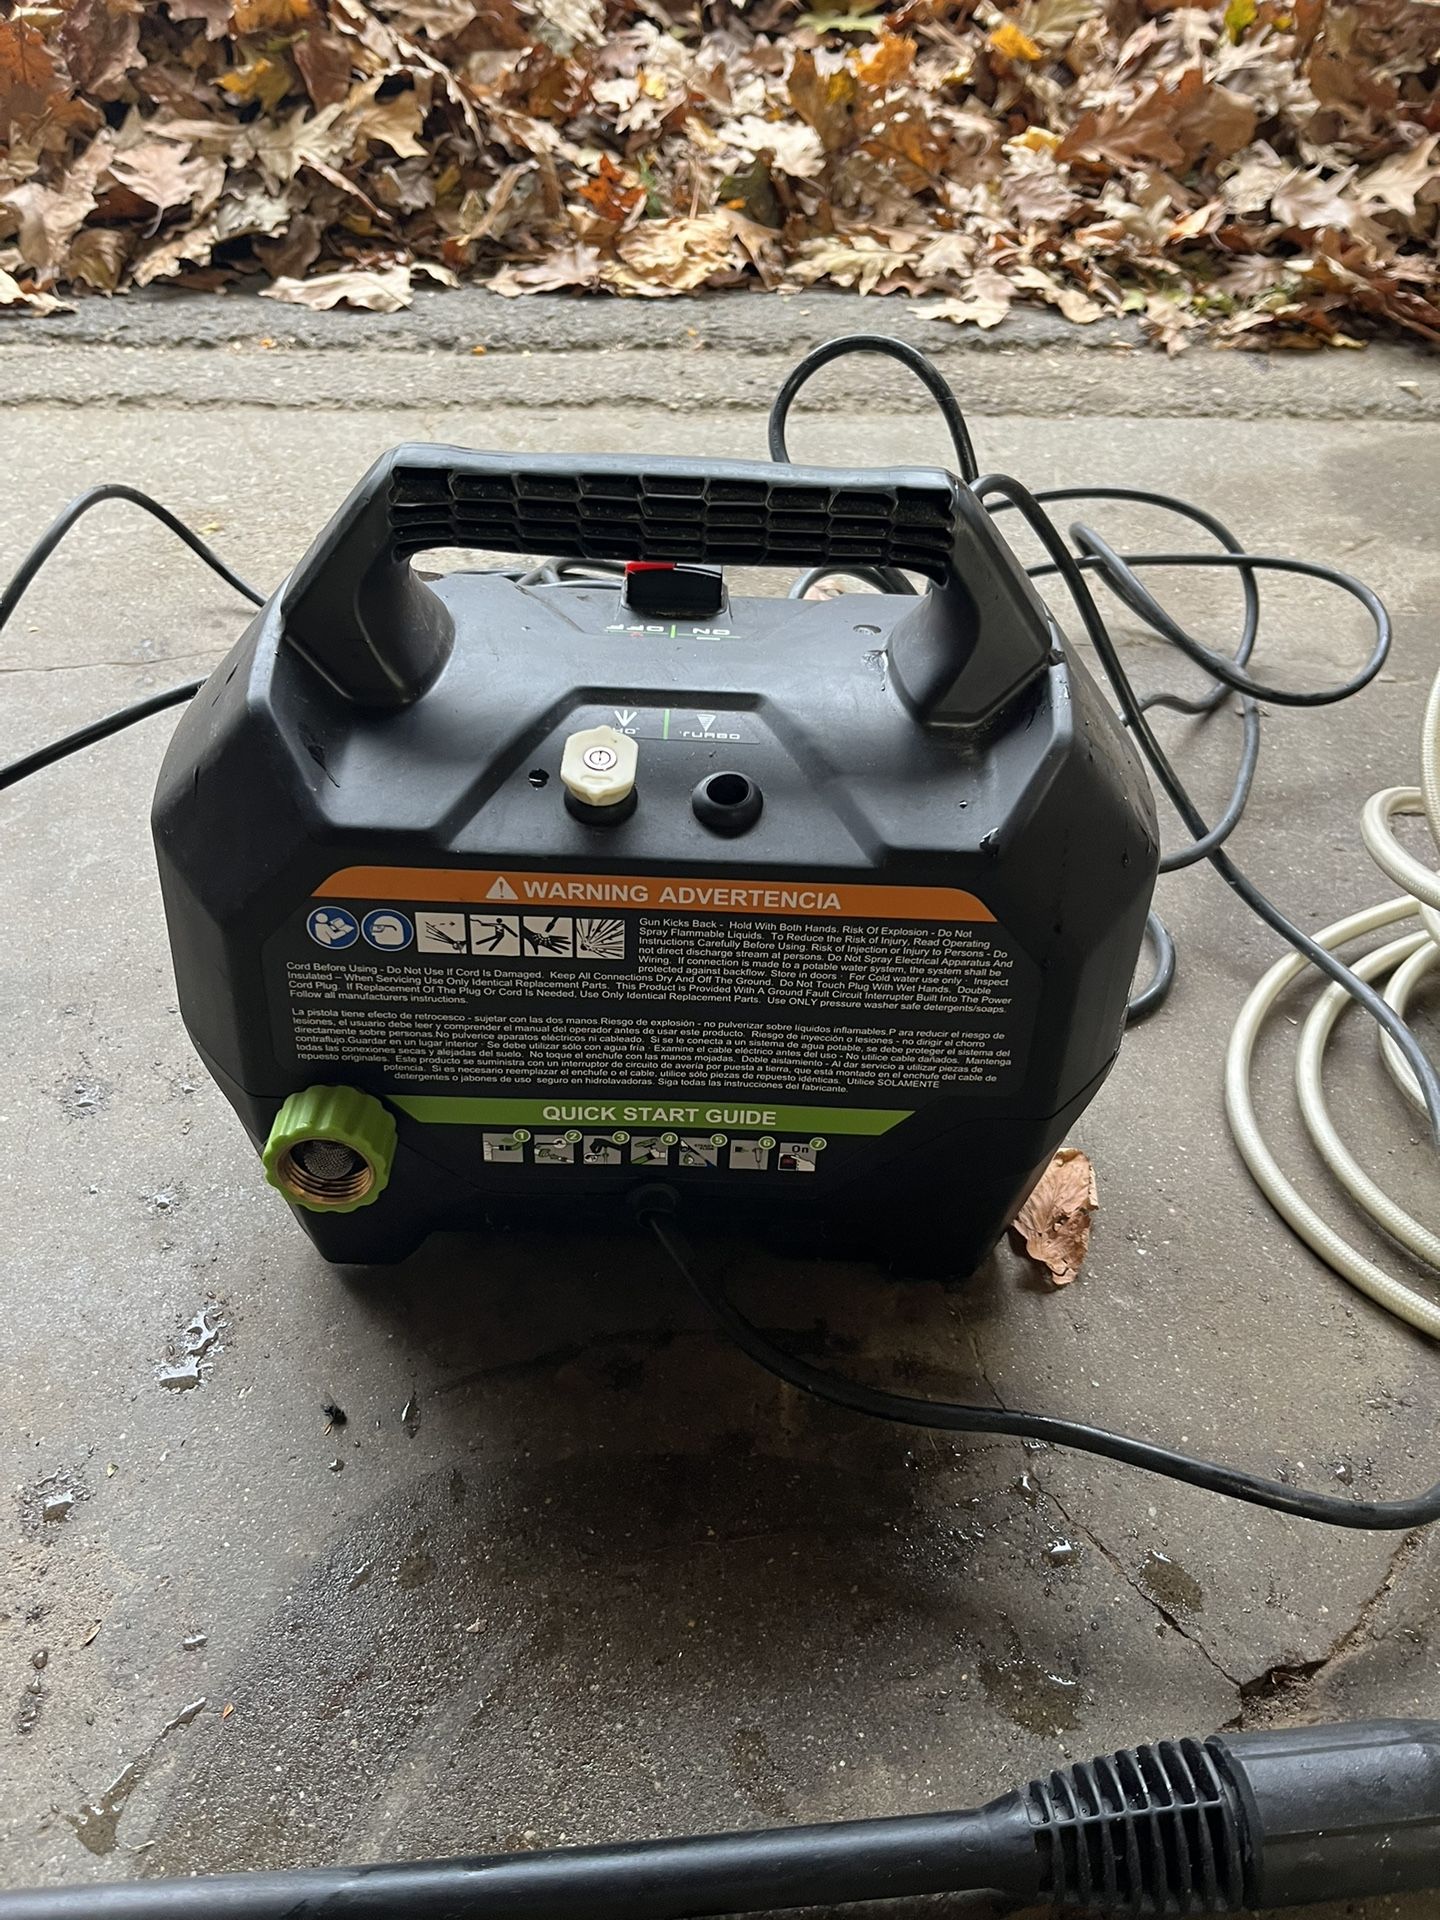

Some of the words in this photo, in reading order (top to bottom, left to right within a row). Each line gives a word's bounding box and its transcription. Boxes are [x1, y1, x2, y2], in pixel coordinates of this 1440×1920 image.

[679, 731, 741, 740] TURBO
[523, 881, 648, 902] WARNING
[659, 886, 841, 909] ADVERTENCIA
[639, 917, 660, 925] Gun
[663, 918, 689, 927] Kicks
[692, 919, 716, 928] Back
[729, 921, 751, 929] Hold
[754, 922, 776, 930] With
[779, 922, 801, 931] Both
[804, 924, 838, 933] Hands.
[842, 925, 863, 934] Risk
[866, 926, 878, 934] Of
[881, 926, 928, 937] Explosion
[937, 928, 952, 937] Do
[954, 929, 971, 937] Not
[639, 927, 667, 937] Spray
[670, 928, 724, 937] Flammable
[727, 930, 764, 940] Liquids.
[771, 932, 783, 940] To
[786, 932, 823, 941] Reduce
[826, 934, 842, 942] the
[844, 934, 865, 943] Risk
[868, 935, 878, 944] of
[881, 936, 909, 946] Injury,
[913, 937, 939, 946] Read
[942, 938, 990, 949] Operating
[639, 936, 694, 946] Instructions
[697, 938, 740, 949] Carefully
[743, 940, 774, 949] Before
[778, 942, 807, 952] Using.
[811, 943, 832, 951] Risk
[835, 944, 844, 952] of
[847, 944, 887, 955] Injection
[902, 946, 929, 957] Injury
[944, 948, 983, 957] Persons
[993, 949, 1007, 958] Do
[638, 946, 653, 954] not
[656, 946, 683, 955] direct
[685, 948, 732, 958] discharge
[735, 950, 768, 958] stream
[771, 951, 780, 959] at
[783, 953, 823, 961] persons.
[827, 953, 841, 961] Do
[844, 954, 861, 962] Not
[864, 954, 892, 965] Spray
[895, 955, 939, 965] Electrical
[941, 957, 990, 968] Apparatus
[993, 959, 1013, 967] And
[638, 955, 671, 965] Wiring.
[678, 956, 683, 964] If
[686, 957, 738, 966] connection
[752, 959, 779, 968] made
[802, 962, 837, 971] potable
[840, 963, 867, 971] water
[870, 965, 905, 974] system,
[909, 965, 924, 973] the
[927, 967, 961, 976] system
[964, 967, 986, 976] shall
[989, 968, 1001, 976] be
[638, 964, 682, 974] protected
[685, 966, 720, 976] against
[723, 967, 767, 976] backflow.
[770, 969, 796, 977] Store
[809, 971, 836, 979] doors
[849, 972, 865, 980] For
[868, 973, 890, 981] Cold
[941, 976, 962, 986] only
[973, 977, 1008, 987] Inspect
[288, 980, 312, 988] Cord
[315, 981, 339, 991] Plug.
[355, 982, 419, 993] Replacement
[422, 985, 434, 993] Of
[437, 985, 456, 994] The
[458, 986, 480, 996] Plug
[483, 987, 495, 995] Or
[498, 987, 522, 996] Cord
[525, 988, 533, 996] Is
[536, 989, 576, 997] Needed,
[579, 990, 598, 998] Use
[601, 990, 623, 1000] Only
[626, 991, 666, 1000] Identical
[669, 992, 731, 1002] Replacement
[734, 994, 760, 1002] Parts.
[767, 996, 785, 1004] Use
[788, 997, 816, 1005] ONLY
[820, 1000, 861, 1008] pressure
[863, 1001, 898, 1009] washer
[900, 1001, 920, 1010] safe
[923, 1003, 1006, 1014] detergents/soaps.
[289, 989, 321, 998] Follow
[338, 991, 408, 1001] manufacturers
[410, 994, 468, 1003] instructions.
[291, 1007, 304, 1015] La
[307, 1008, 338, 1017] pistola
[367, 1010, 397, 1018] efecto
[399, 1011, 411, 1019] de
[474, 1014, 506, 1024] sujetar
[529, 1015, 543, 1023] las
[650, 1019, 694, 1028] explosión
[718, 1021, 762, 1030] pulverizar
[766, 1023, 792, 1031] sobre
[794, 1024, 830, 1033] líquidos
[916, 1029, 948, 1037] reducir
[950, 1030, 959, 1038] el
[961, 1032, 990, 1040] riesgo
[394, 1072, 449, 1082] detergentes
[460, 1074, 497, 1083] jabones
[536, 1077, 568, 1085] seguro
[658, 1078, 678, 1087] Siga
[723, 1080, 782, 1088] instrucciones
[543, 1106, 617, 1121] QUICK
[624, 1108, 699, 1122] START
[706, 1110, 776, 1124] GUIDE
[792, 1145, 809, 1153] On
